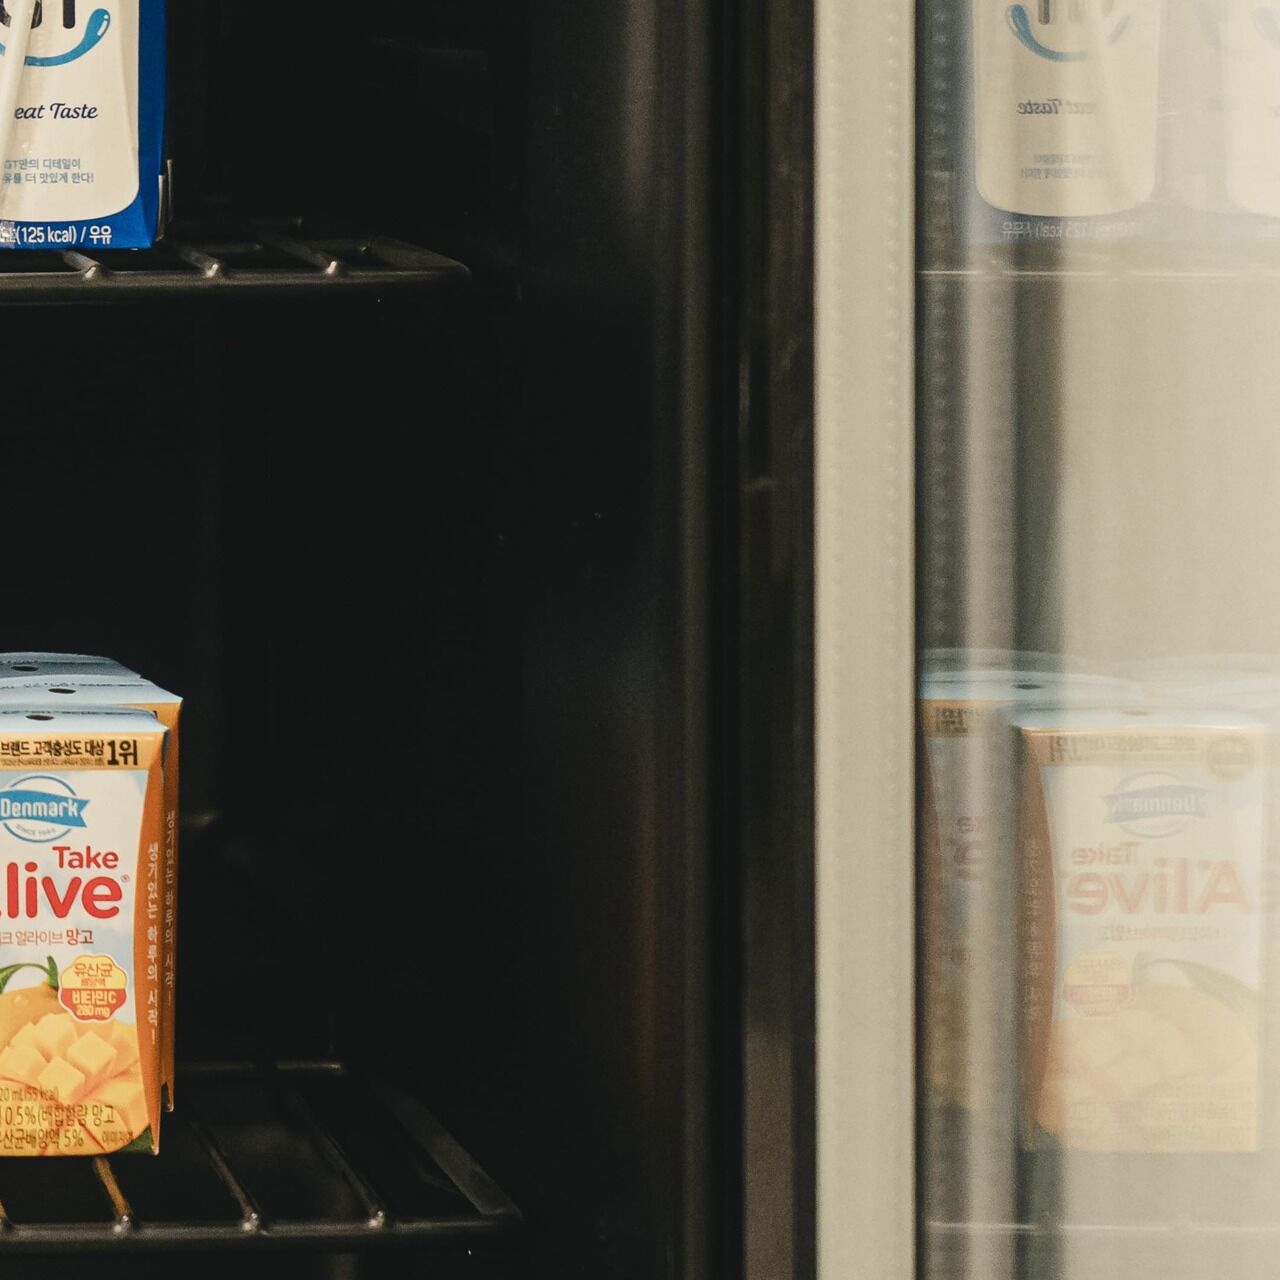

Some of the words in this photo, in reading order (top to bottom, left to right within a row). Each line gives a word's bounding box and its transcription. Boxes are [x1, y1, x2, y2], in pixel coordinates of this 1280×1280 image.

[50, 103, 98, 119] Taste
[48, 226, 76, 244] kcal)
[89, 225, 112, 244] 우유
[0, 741, 30, 757] 브랜드
[84, 740, 104, 757] 대상
[107, 740, 138, 766] 1위
[1, 798, 78, 818] Denmark
[52, 846, 119, 869] Take
[15, 930, 63, 946] 얼라이브
[66, 928, 94, 946] 망고
